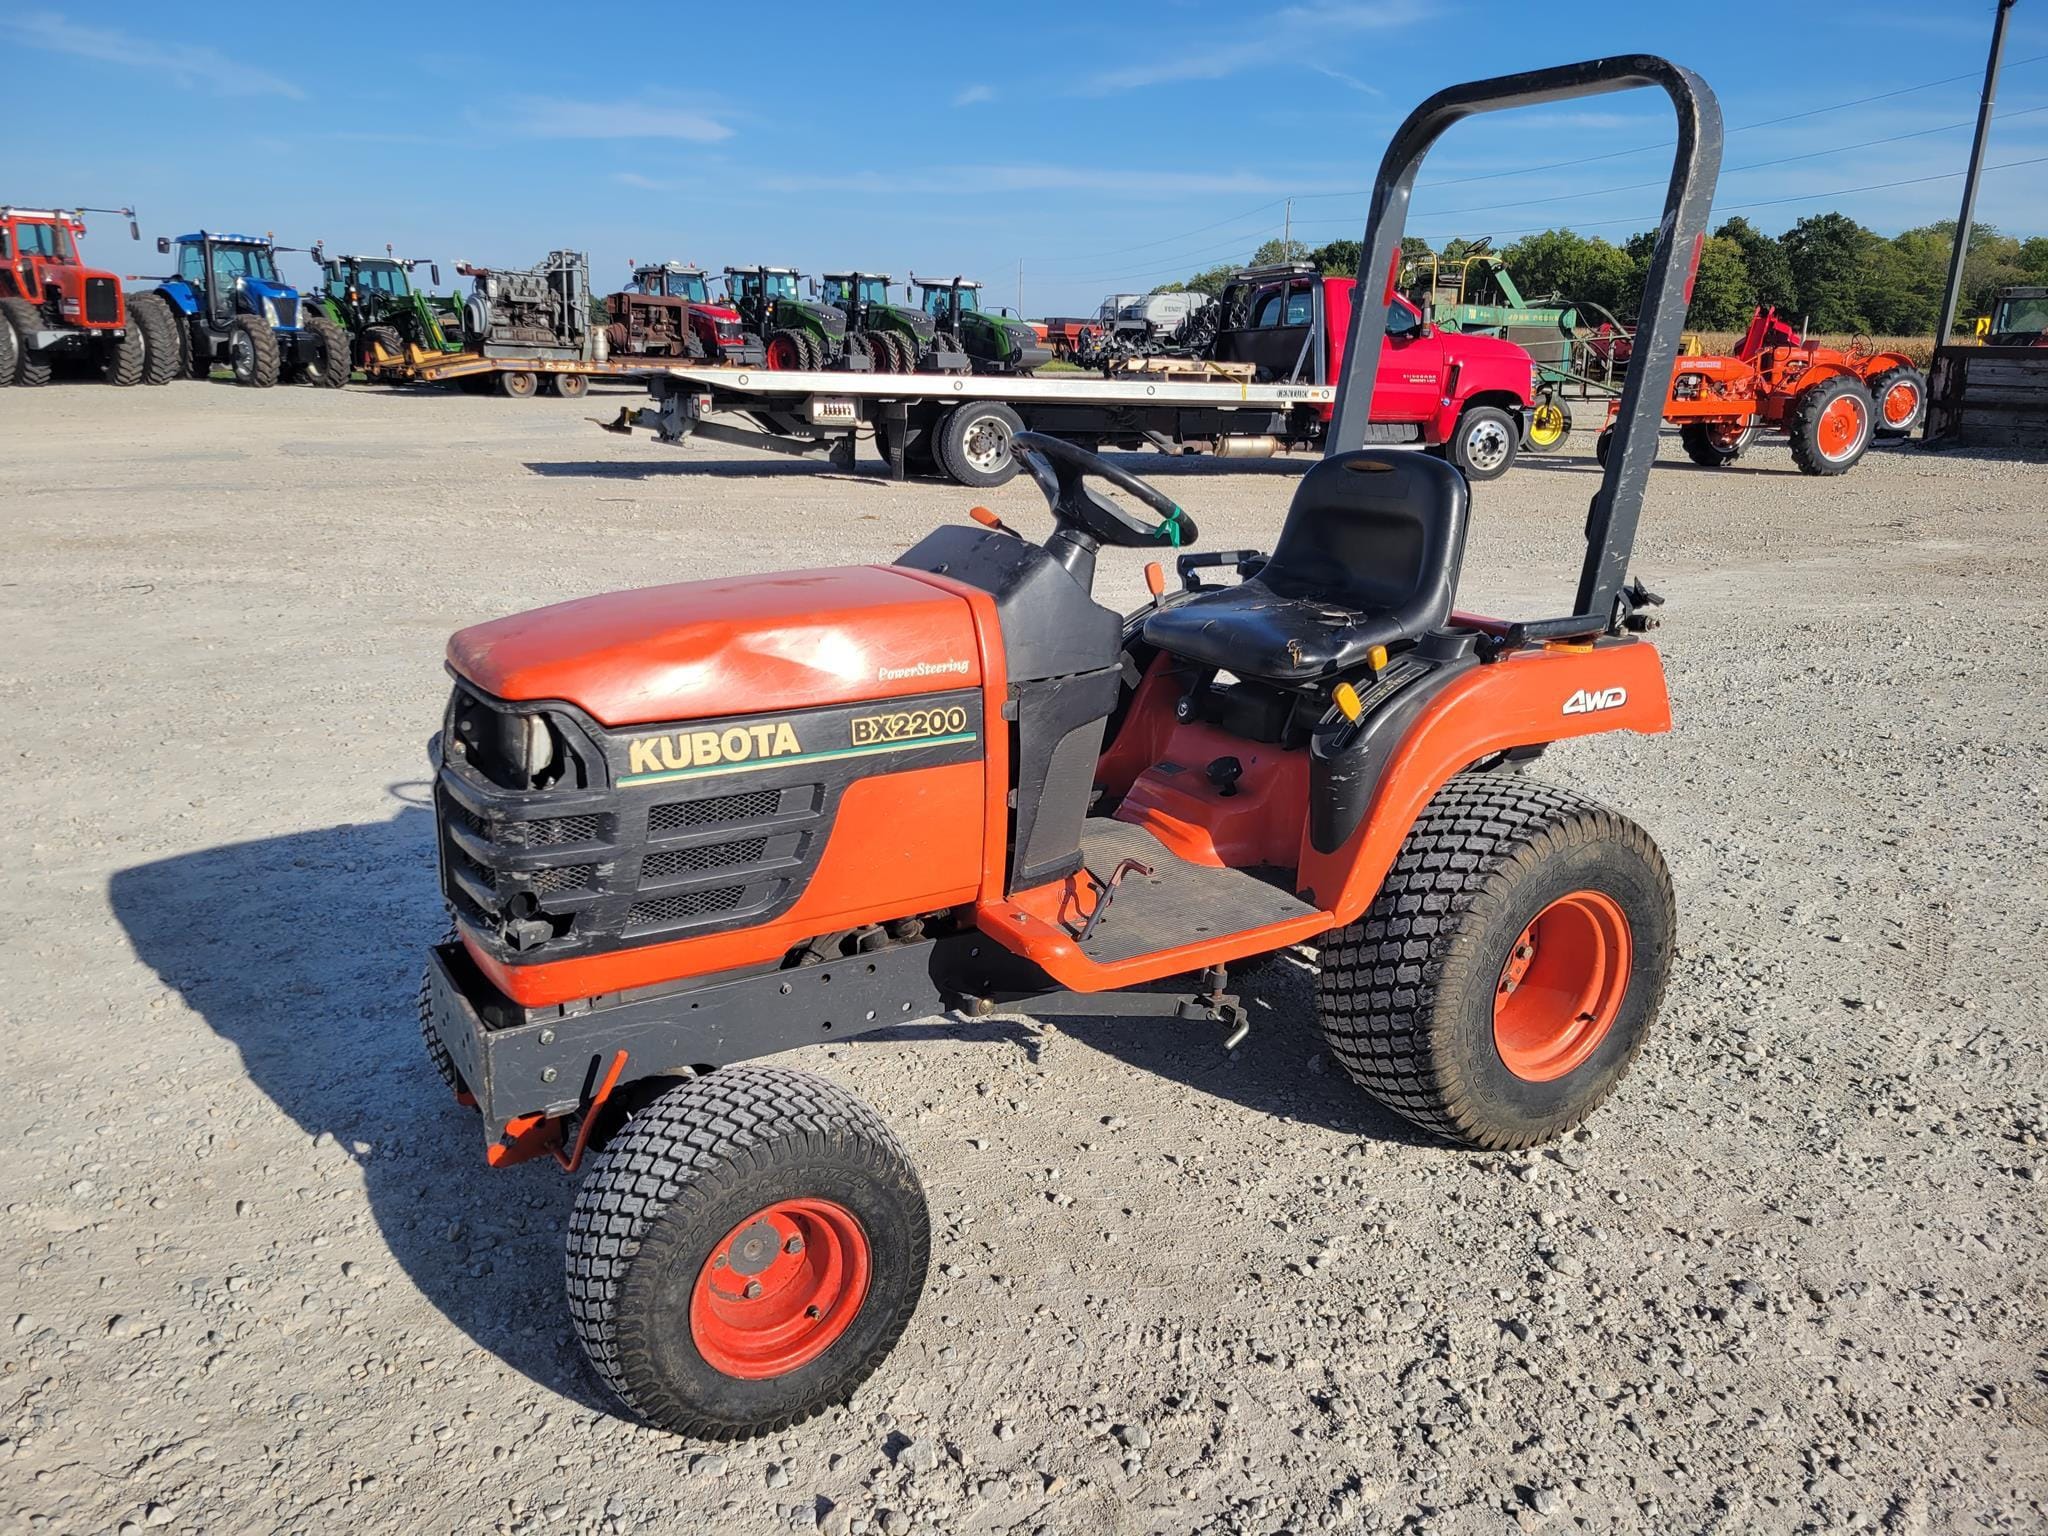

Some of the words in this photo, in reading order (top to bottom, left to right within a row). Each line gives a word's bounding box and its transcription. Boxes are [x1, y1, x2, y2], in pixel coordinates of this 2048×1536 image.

[878, 659, 969, 681] PowerSteering
[1562, 687, 1628, 715] 4WD
[851, 706, 967, 746] BX2200
[629, 721, 802, 774] KUBOTA
